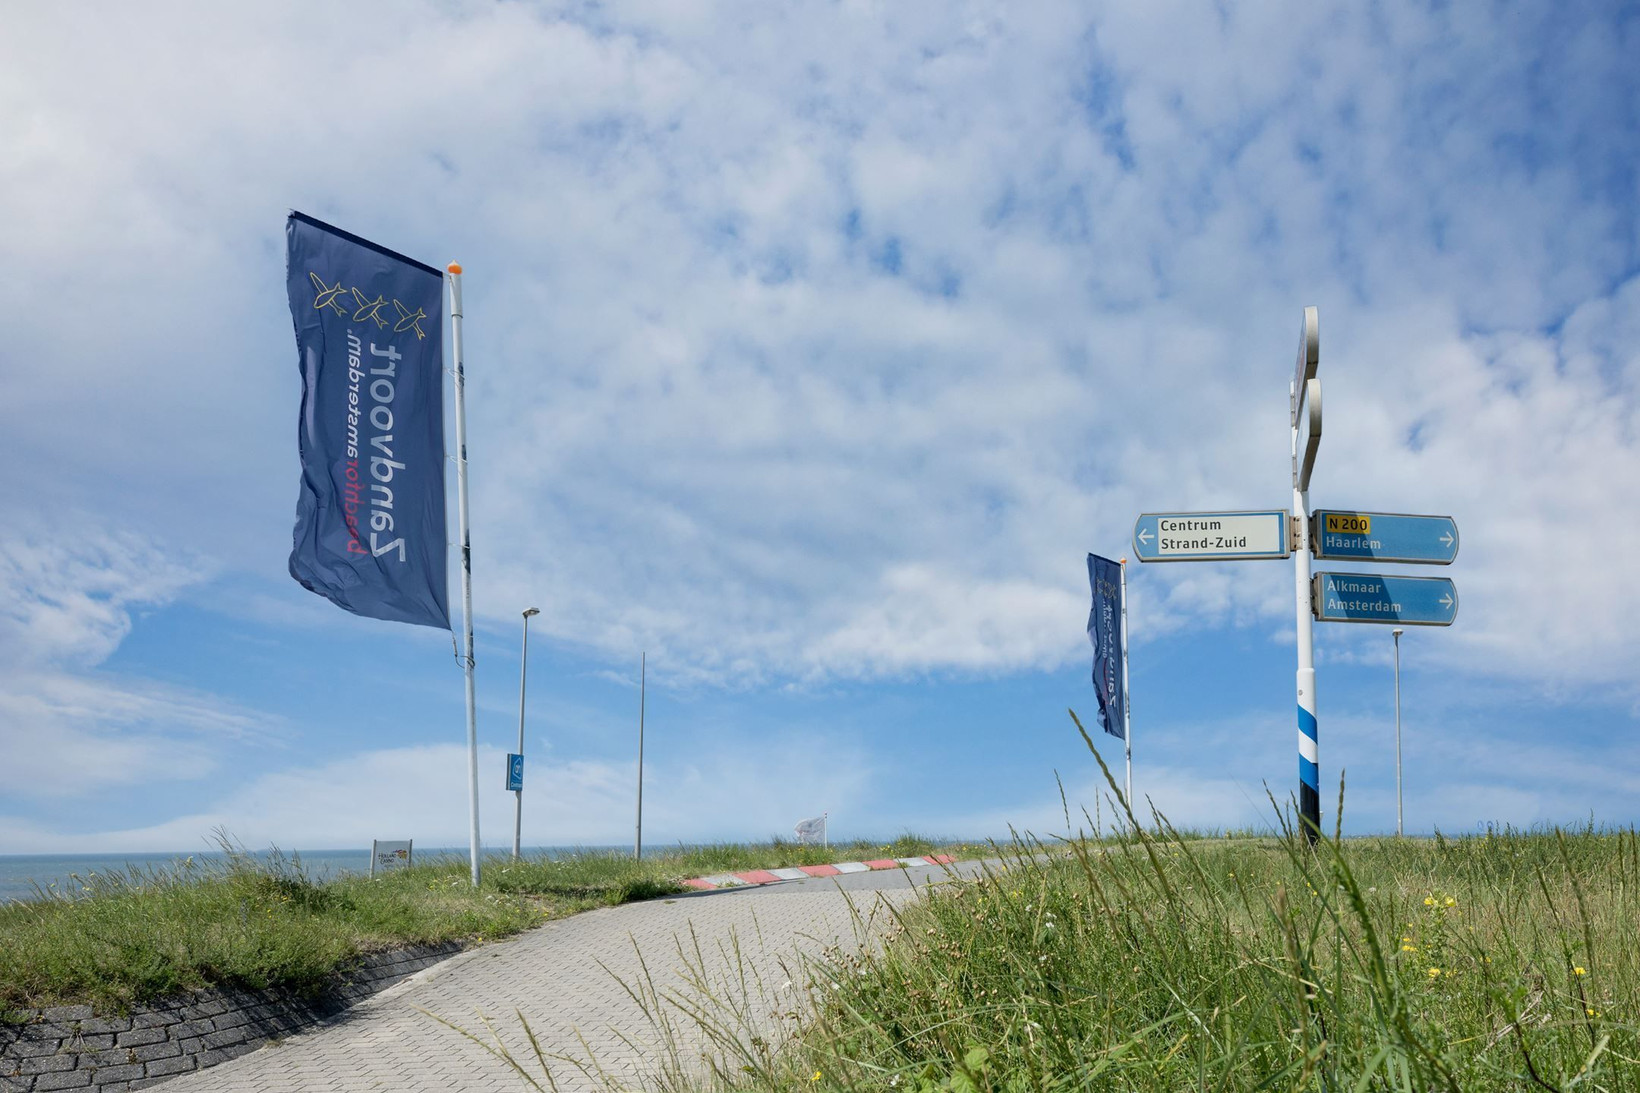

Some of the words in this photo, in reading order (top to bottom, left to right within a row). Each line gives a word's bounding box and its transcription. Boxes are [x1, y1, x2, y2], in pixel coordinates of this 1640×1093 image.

[1160, 519, 1222, 532] Centrum
[1329, 518, 1338, 529] N
[1341, 518, 1368, 531] 200
[1161, 536, 1247, 550] Strand-Zuid
[1326, 535, 1381, 550] Haarlem
[1327, 579, 1381, 594] Alkmaar
[1328, 598, 1402, 613] Amsterdam
